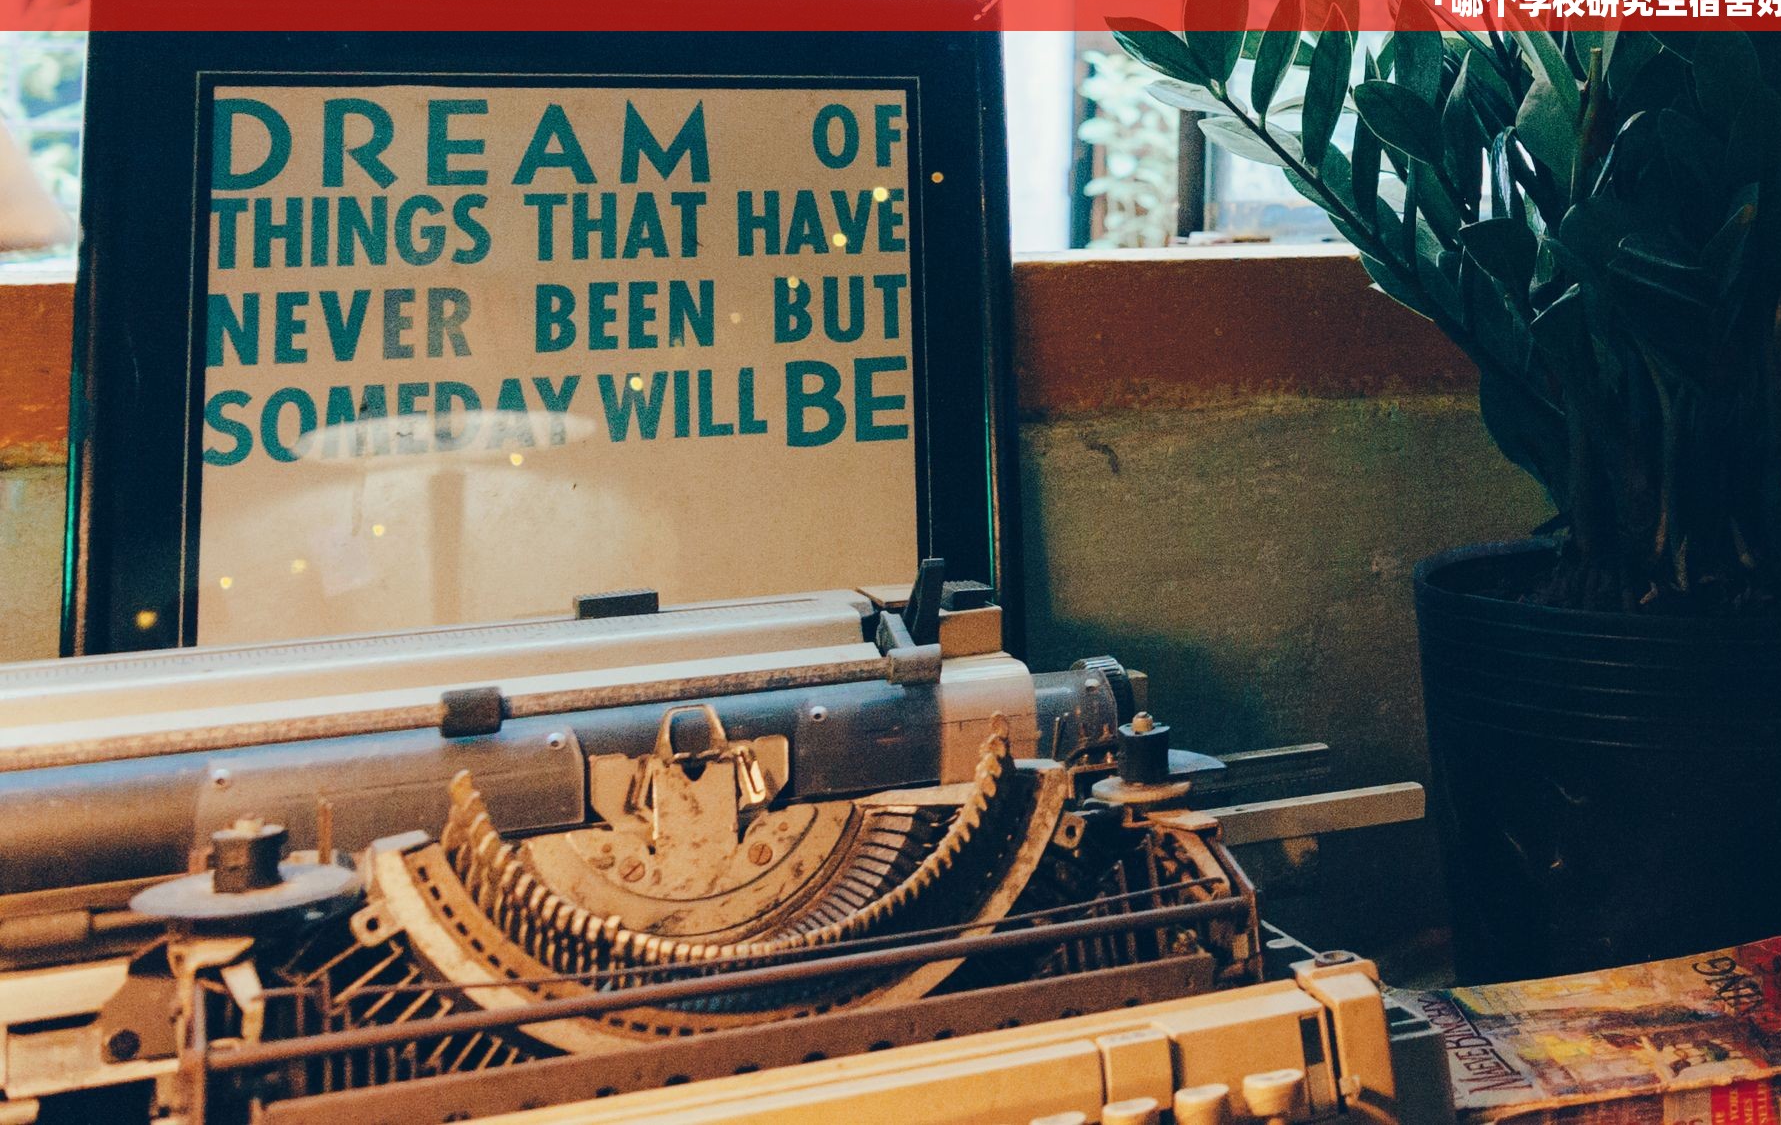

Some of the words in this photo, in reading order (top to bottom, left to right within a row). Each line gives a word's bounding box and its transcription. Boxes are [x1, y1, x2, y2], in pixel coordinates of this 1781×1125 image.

[211, 98, 711, 191] DREAM
[812, 103, 902, 169] OF
[209, 193, 492, 269] THINGS
[523, 191, 706, 261] THAT
[737, 188, 906, 257] HAVE
[205, 287, 472, 368] NEVER
[535, 279, 714, 353] BEEN
[774, 273, 907, 344] BUT
[203, 374, 581, 467] SOMEDAY
[597, 366, 768, 443] WILL
[785, 356, 909, 448] BE
